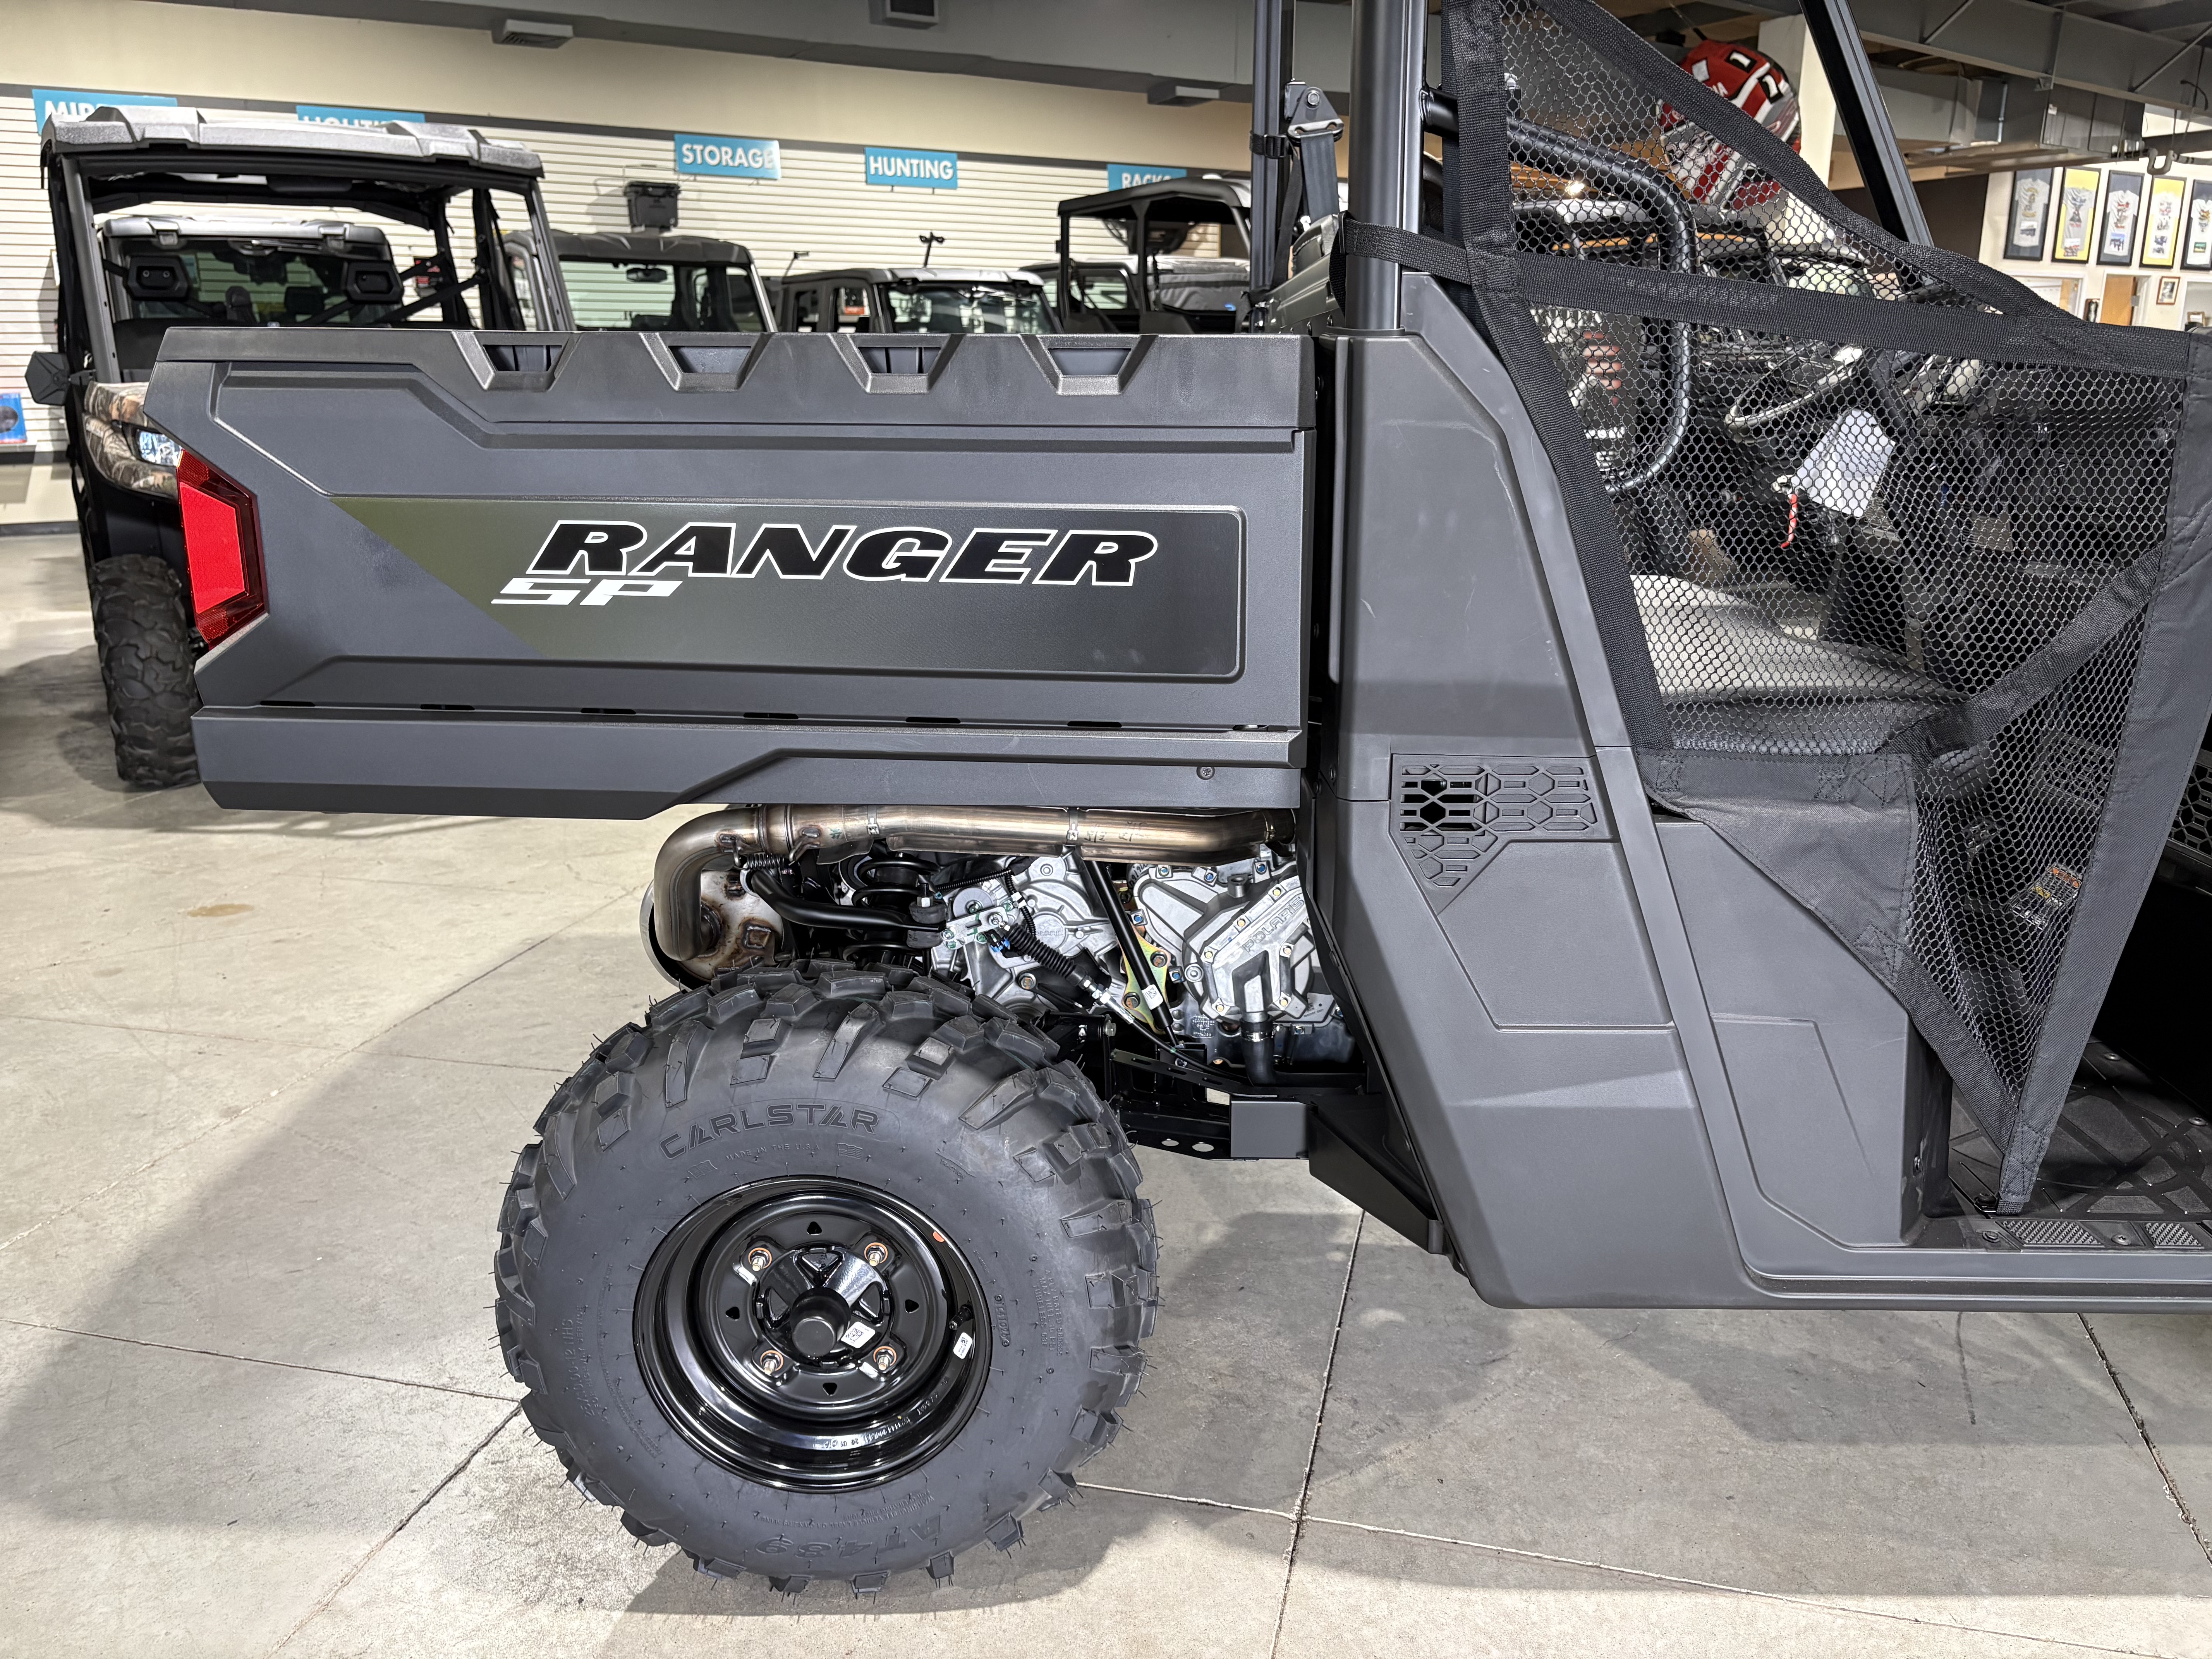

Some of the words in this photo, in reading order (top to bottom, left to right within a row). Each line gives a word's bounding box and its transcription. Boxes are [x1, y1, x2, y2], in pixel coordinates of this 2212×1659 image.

[682, 143, 774, 169] STORAGE
[869, 156, 954, 180] HUNTING
[526, 519, 1158, 586] RANGER
[491, 577, 683, 605] SP
[1242, 896, 1305, 953] POLARIS
[659, 1104, 879, 1159] CARLSTAR
[726, 1150, 752, 1161] MADE
[1033, 1284, 1047, 1327] TUBELESS
[1039, 1277, 1051, 1296] MAX
[1047, 1336, 1058, 1351] PSI
[1047, 1277, 1056, 1292] PLY
[1052, 1295, 1063, 1324] RATED
